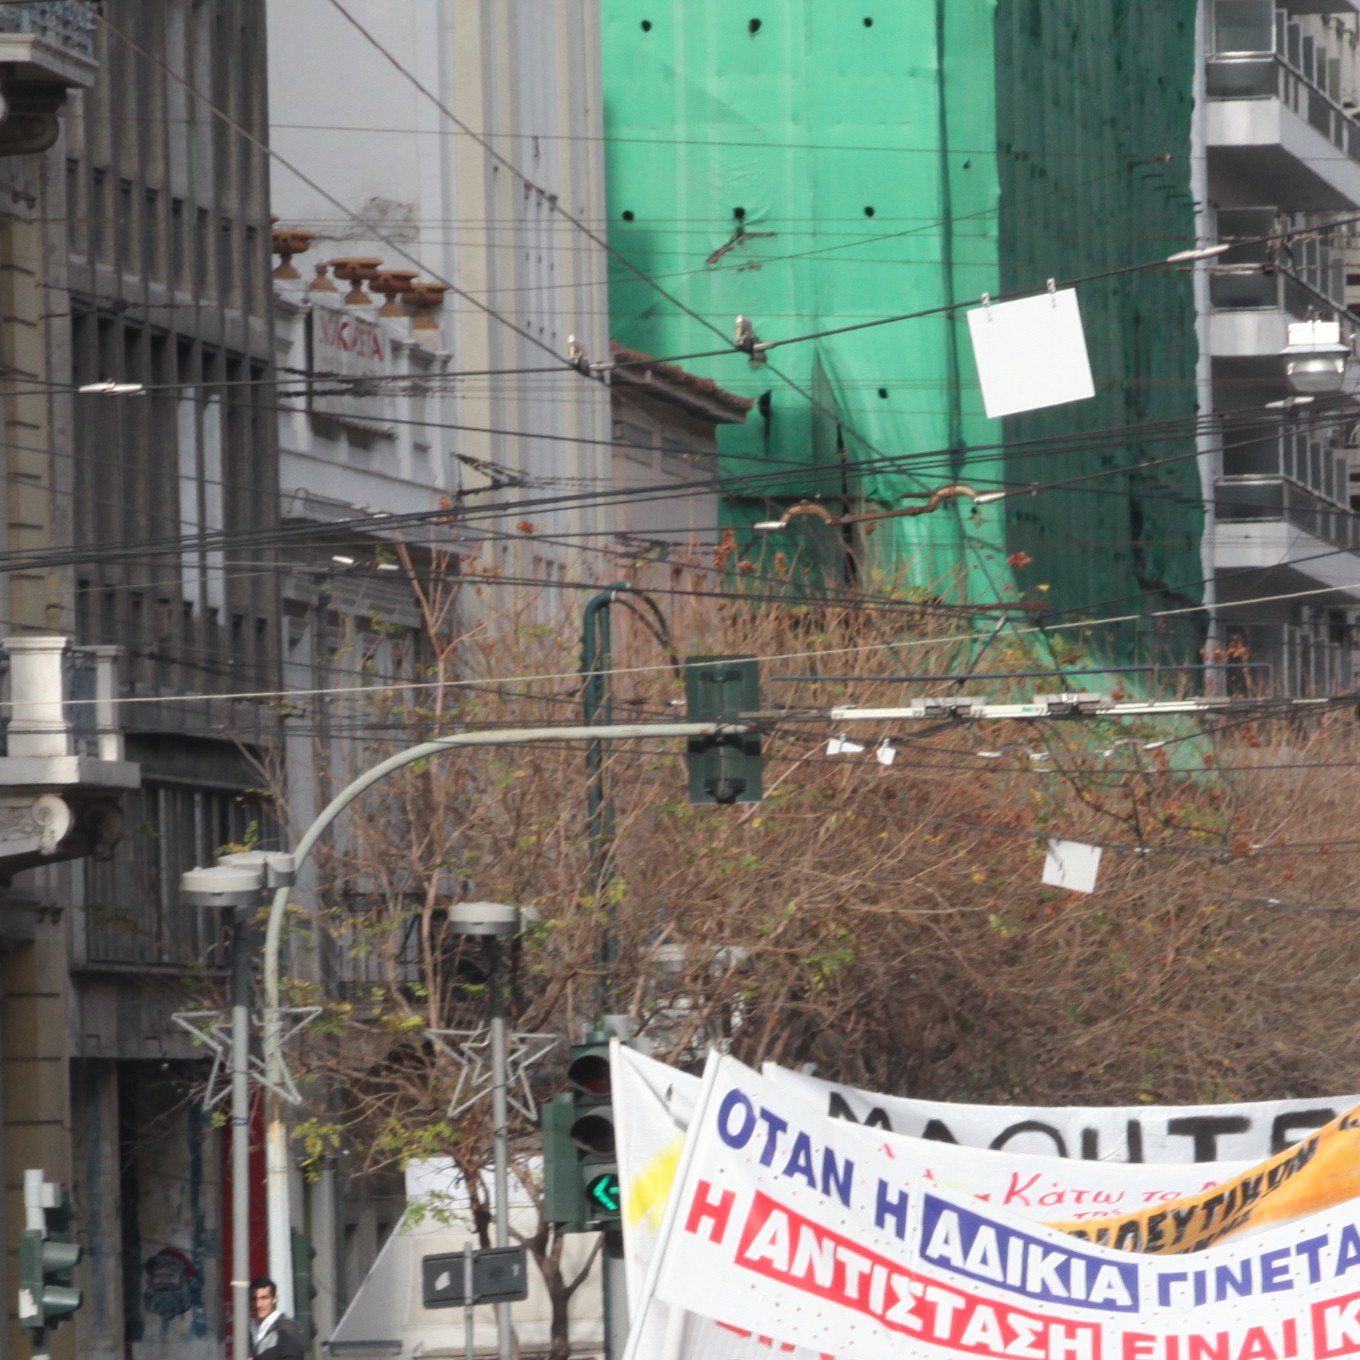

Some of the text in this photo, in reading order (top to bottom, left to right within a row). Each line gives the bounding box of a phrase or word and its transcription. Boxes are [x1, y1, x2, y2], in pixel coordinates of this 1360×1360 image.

[684, 1178, 737, 1246] Η
[717, 1087, 855, 1209] ΟΤΑΝ
[874, 1177, 909, 1242] Η
[924, 1208, 1133, 1307] ΑΔΙΚΙΑ
[1004, 1171, 1126, 1208] Κάτω
